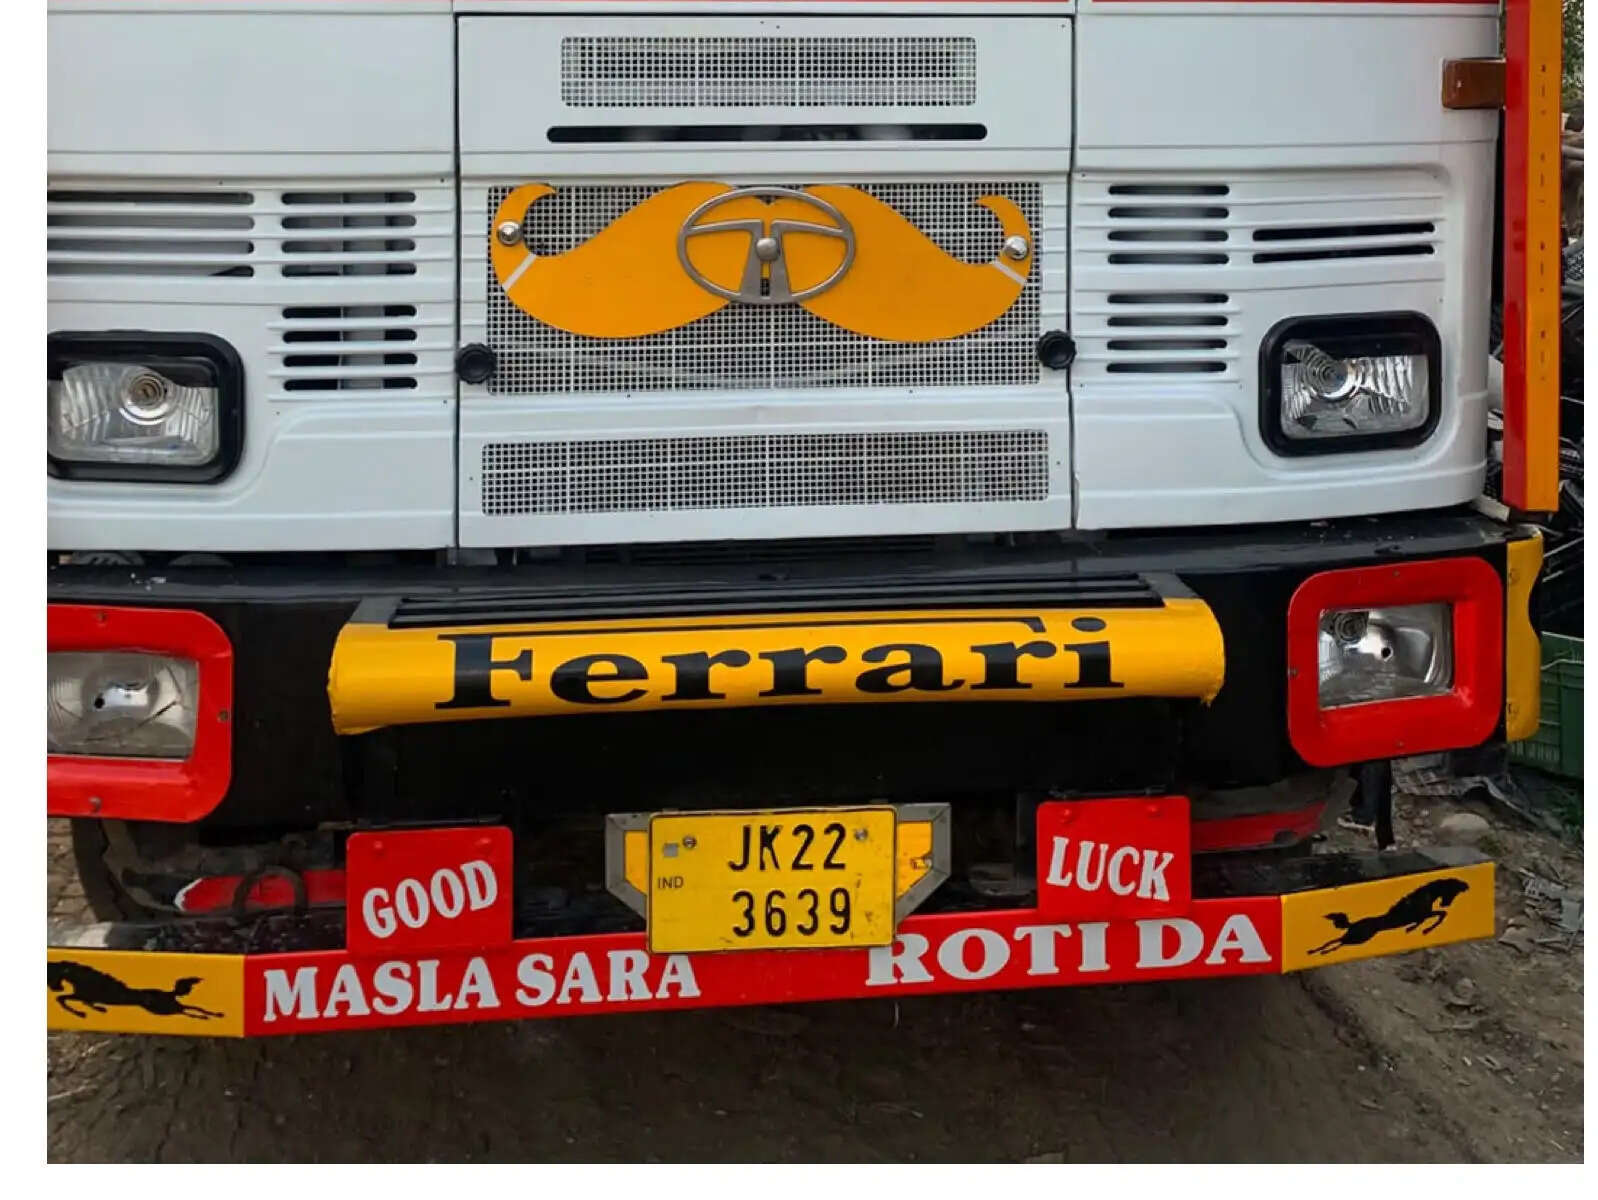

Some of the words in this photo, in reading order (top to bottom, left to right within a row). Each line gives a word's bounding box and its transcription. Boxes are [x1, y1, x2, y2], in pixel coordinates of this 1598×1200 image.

[434, 616, 1125, 710] Ferrari
[728, 823, 847, 872] JK22
[1046, 837, 1174, 902] LUCK
[362, 859, 498, 939] GOOD
[657, 875, 685, 890] IND
[732, 887, 851, 938] 3639
[263, 957, 501, 1022] MASLA
[515, 949, 702, 1006] SARA
[866, 921, 1111, 987] ROTI
[1136, 914, 1272, 970] DA
